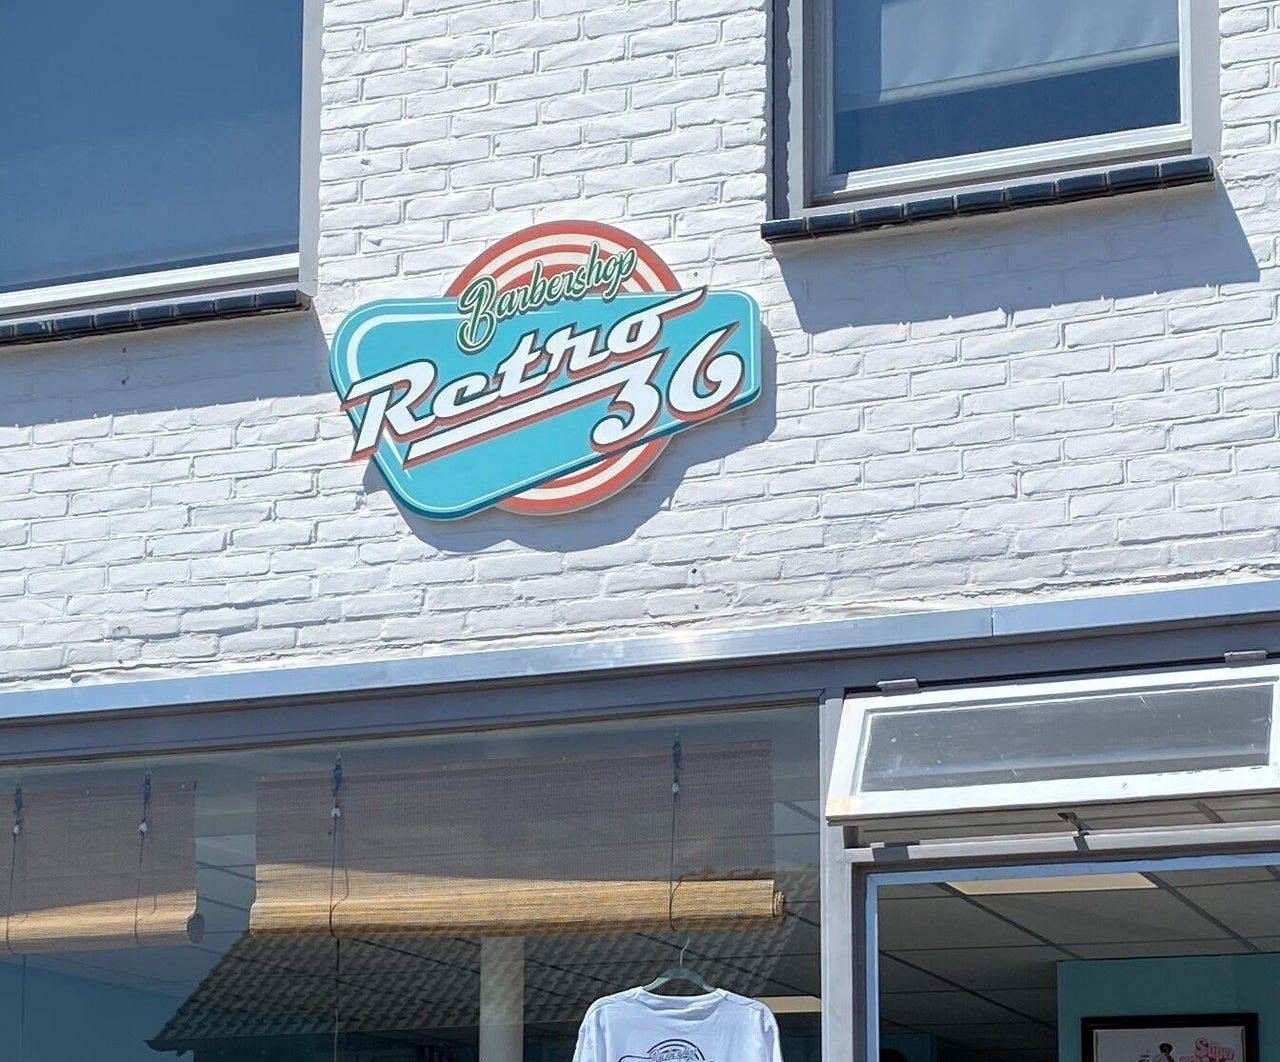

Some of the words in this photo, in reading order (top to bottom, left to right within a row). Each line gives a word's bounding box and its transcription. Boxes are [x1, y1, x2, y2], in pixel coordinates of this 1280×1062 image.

[456, 241, 637, 352] Barbershop
[342, 286, 708, 457] Retro
[590, 322, 746, 451] 36
[1195, 1038, 1235, 1060] Super
